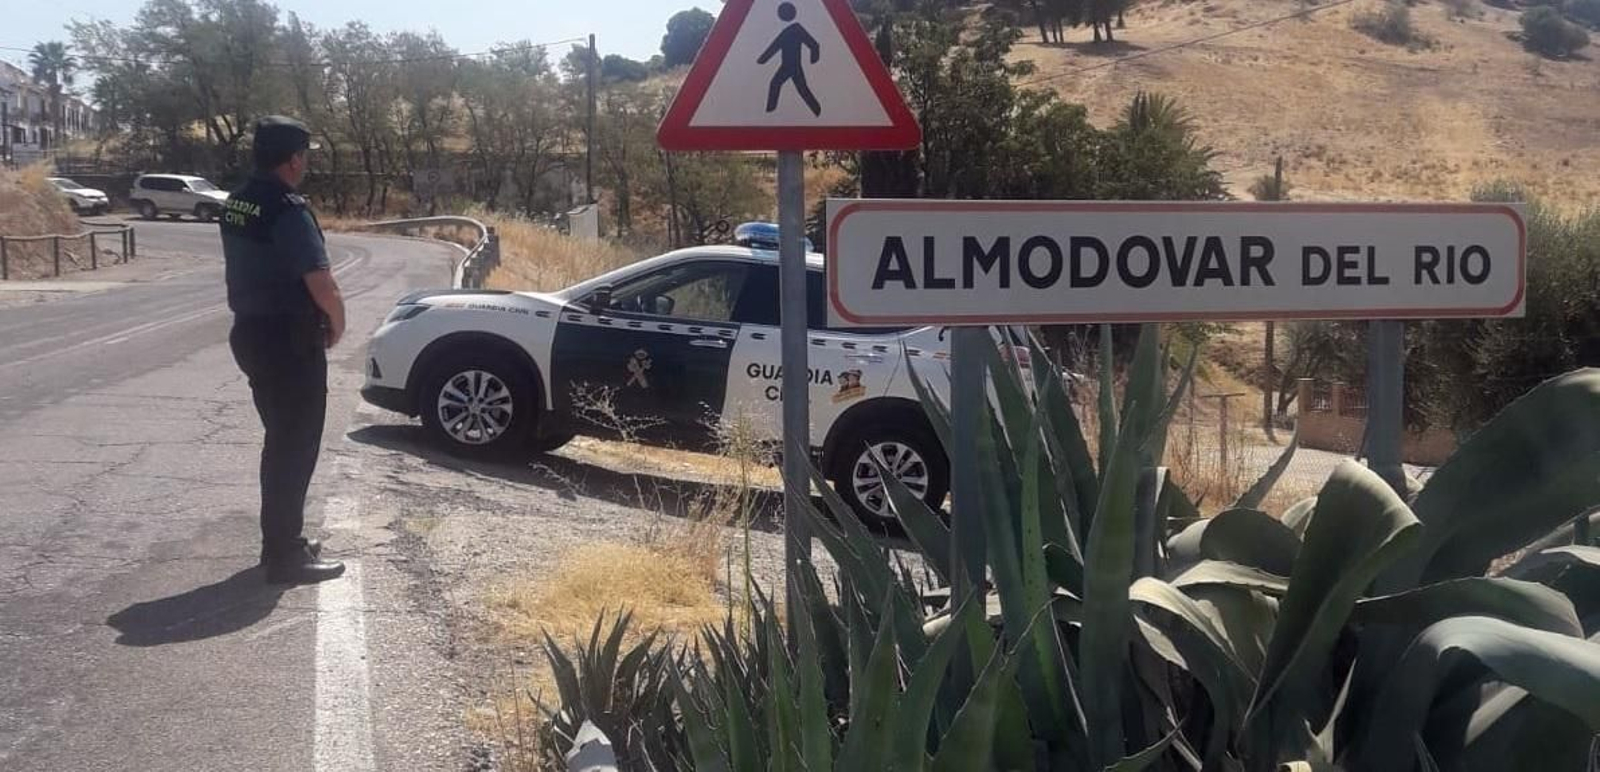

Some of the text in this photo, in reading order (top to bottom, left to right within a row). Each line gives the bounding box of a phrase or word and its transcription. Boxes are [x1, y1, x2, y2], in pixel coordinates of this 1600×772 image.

[871, 235, 1491, 290] ALMODOVAR DEL RIO
[746, 362, 833, 386] GUADIA
